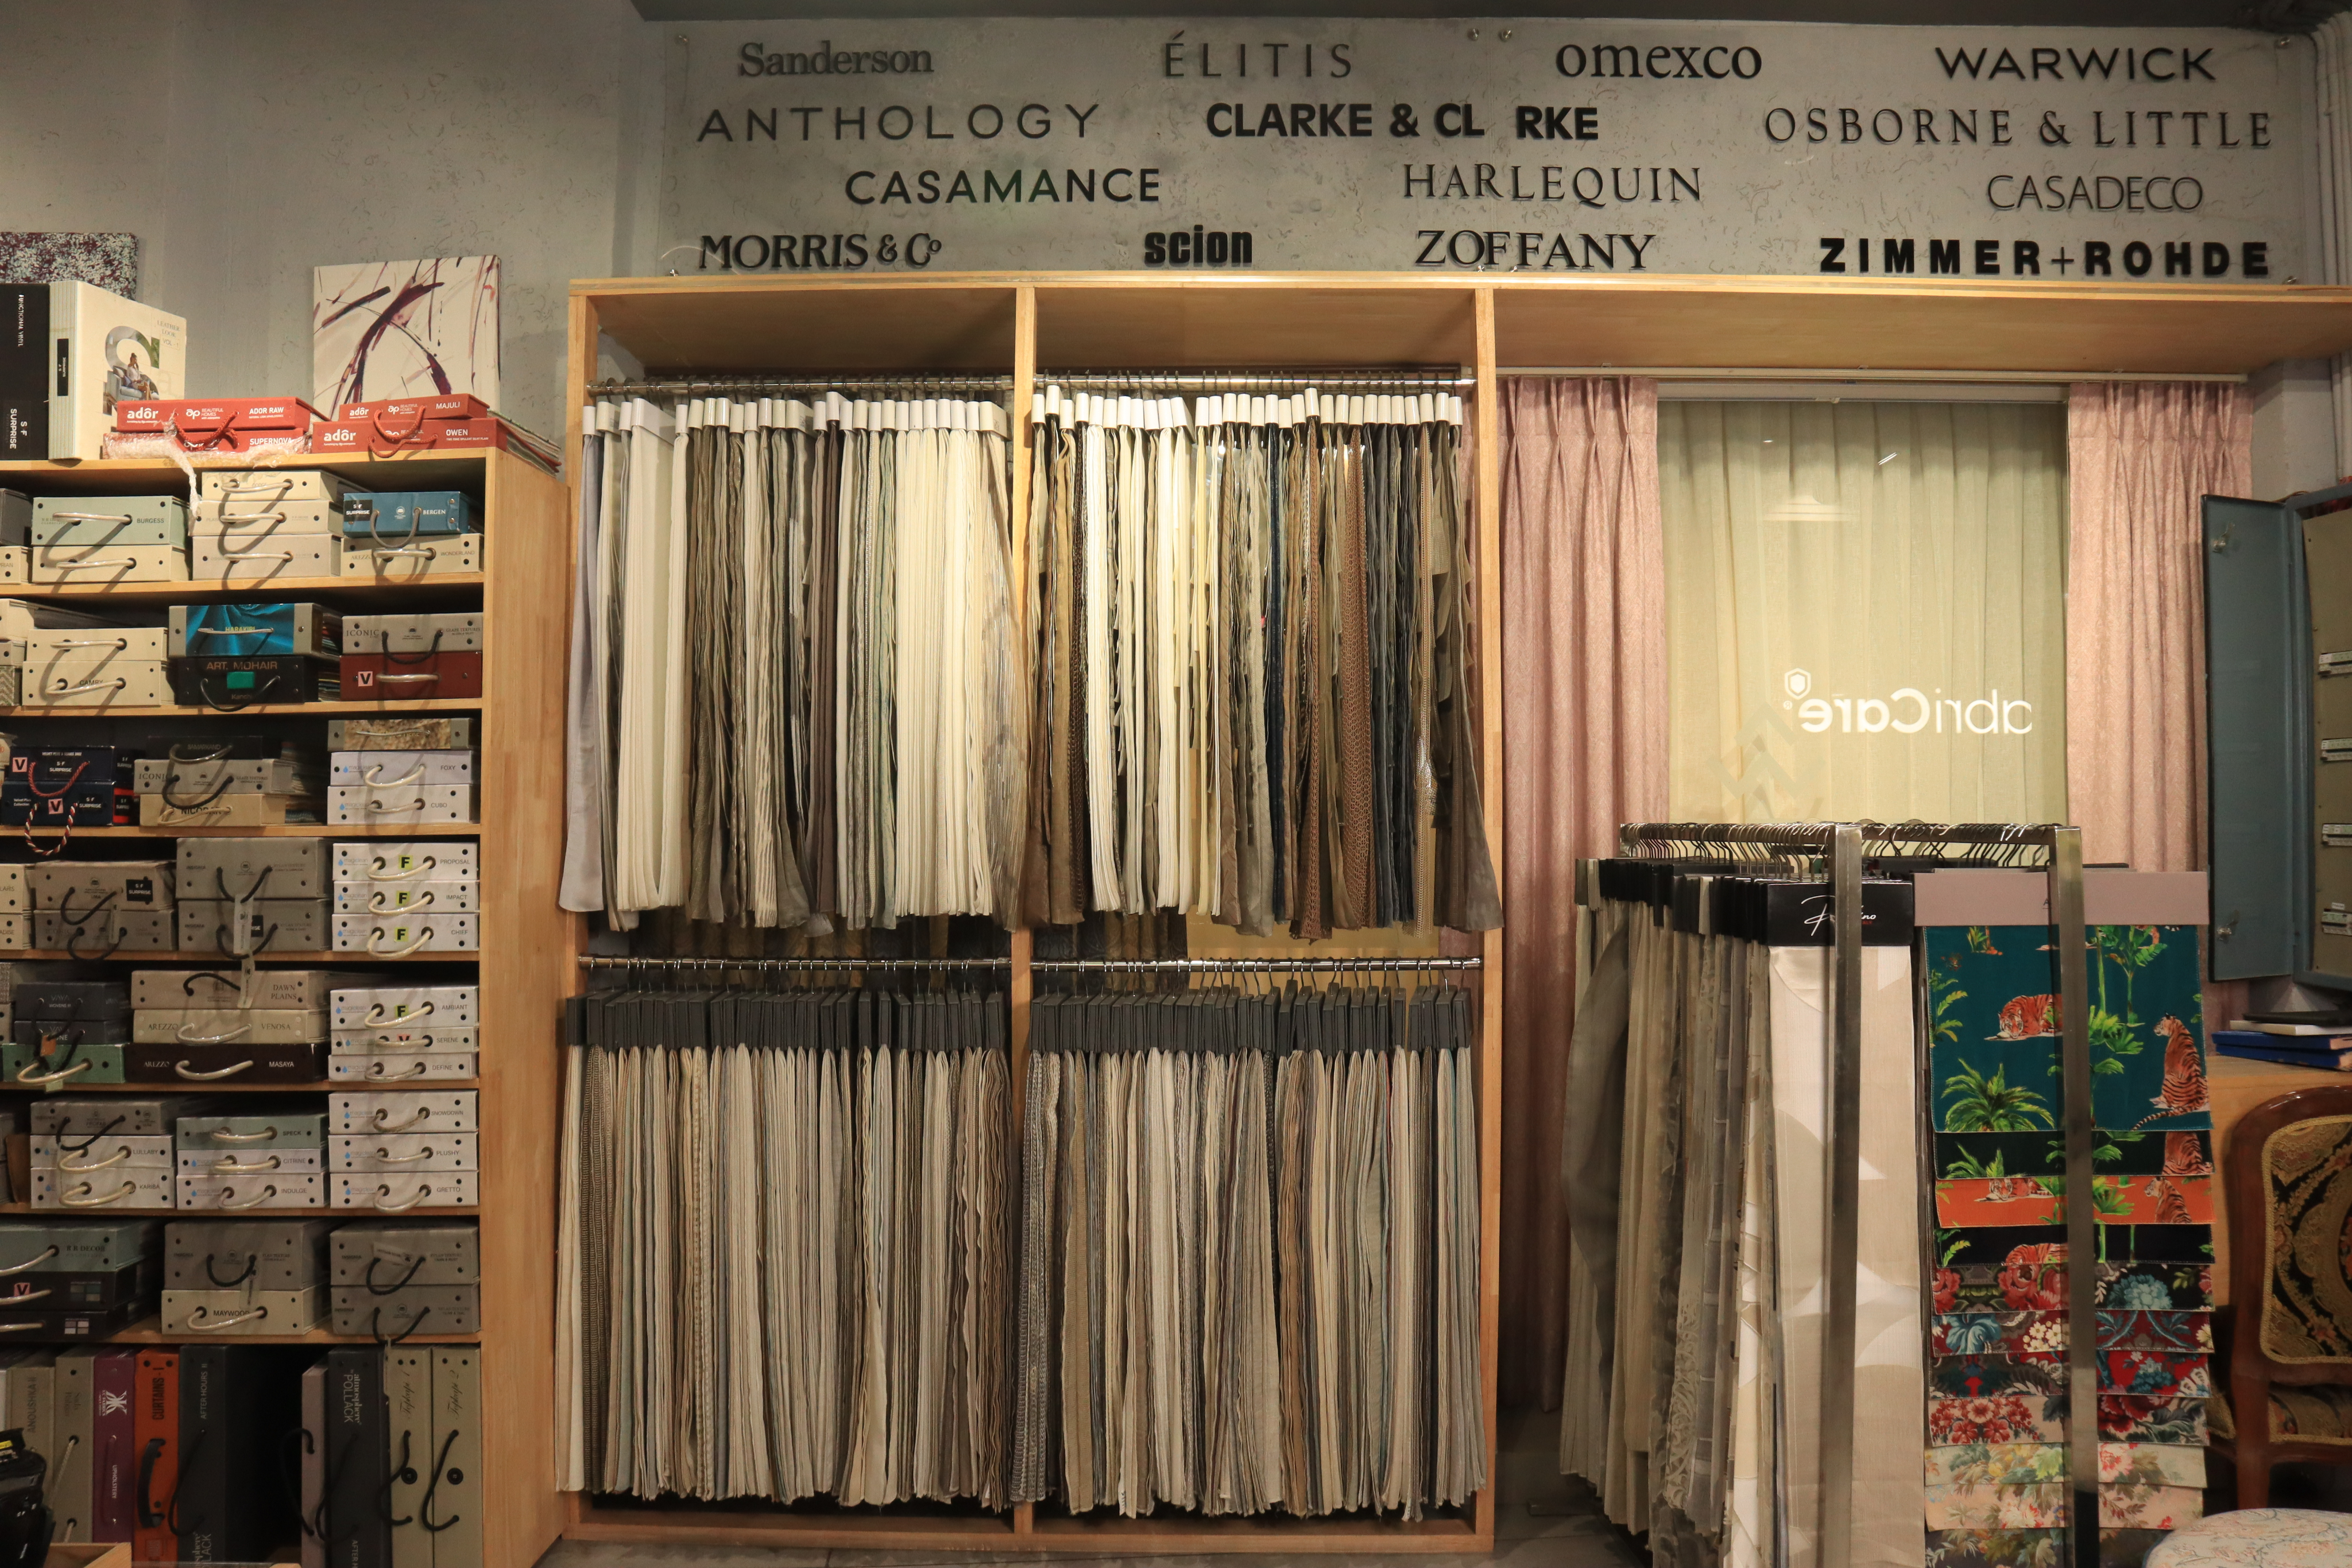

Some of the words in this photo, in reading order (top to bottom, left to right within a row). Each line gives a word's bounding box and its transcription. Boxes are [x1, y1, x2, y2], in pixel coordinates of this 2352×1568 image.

[739, 40, 934, 78] Sanderson
[1164, 30, 1352, 79] ÉLITIS
[1556, 44, 1762, 79] omexco
[1935, 46, 2216, 81] WARWICK
[697, 103, 1099, 142] ANTHOLOGY
[1206, 103, 1373, 137] CLARKE
[1390, 103, 1419, 137] &
[1765, 108, 2013, 145] OSBORNE
[2040, 110, 2071, 145] &
[2094, 112, 2271, 148] LITTLE
[845, 168, 1159, 204] CASAMANCE
[1403, 162, 1701, 208] HARLEQUIN
[1987, 174, 2203, 211] CASADECO
[699, 233, 869, 269] MORRIS
[877, 234, 898, 265] &
[1144, 225, 1252, 266] scion
[1415, 230, 1655, 269] ZOFFANY
[1820, 237, 2268, 276] ZIMMER+ROHDE
[157, 319, 180, 332] LEATHER
[162, 329, 176, 338] LOOK
[163, 338, 171, 346] VOL
[436, 401, 460, 409] MAJULI
[207, 661, 229, 670] ART.
[233, 661, 277, 669] MOHAIR
[360, 673, 371, 684] V
[15, 759, 25, 771] V
[52, 801, 61, 812] V
[401, 857, 410, 868] F
[399, 893, 408, 904] F
[397, 929, 406, 940] F
[397, 1006, 406, 1017] F
[17, 1284, 28, 1295] V
[27, 1384, 37, 1433] ANOUSHKA
[152, 1378, 165, 1420] CURTAINS
[343, 1375, 354, 1423] POLLACK
